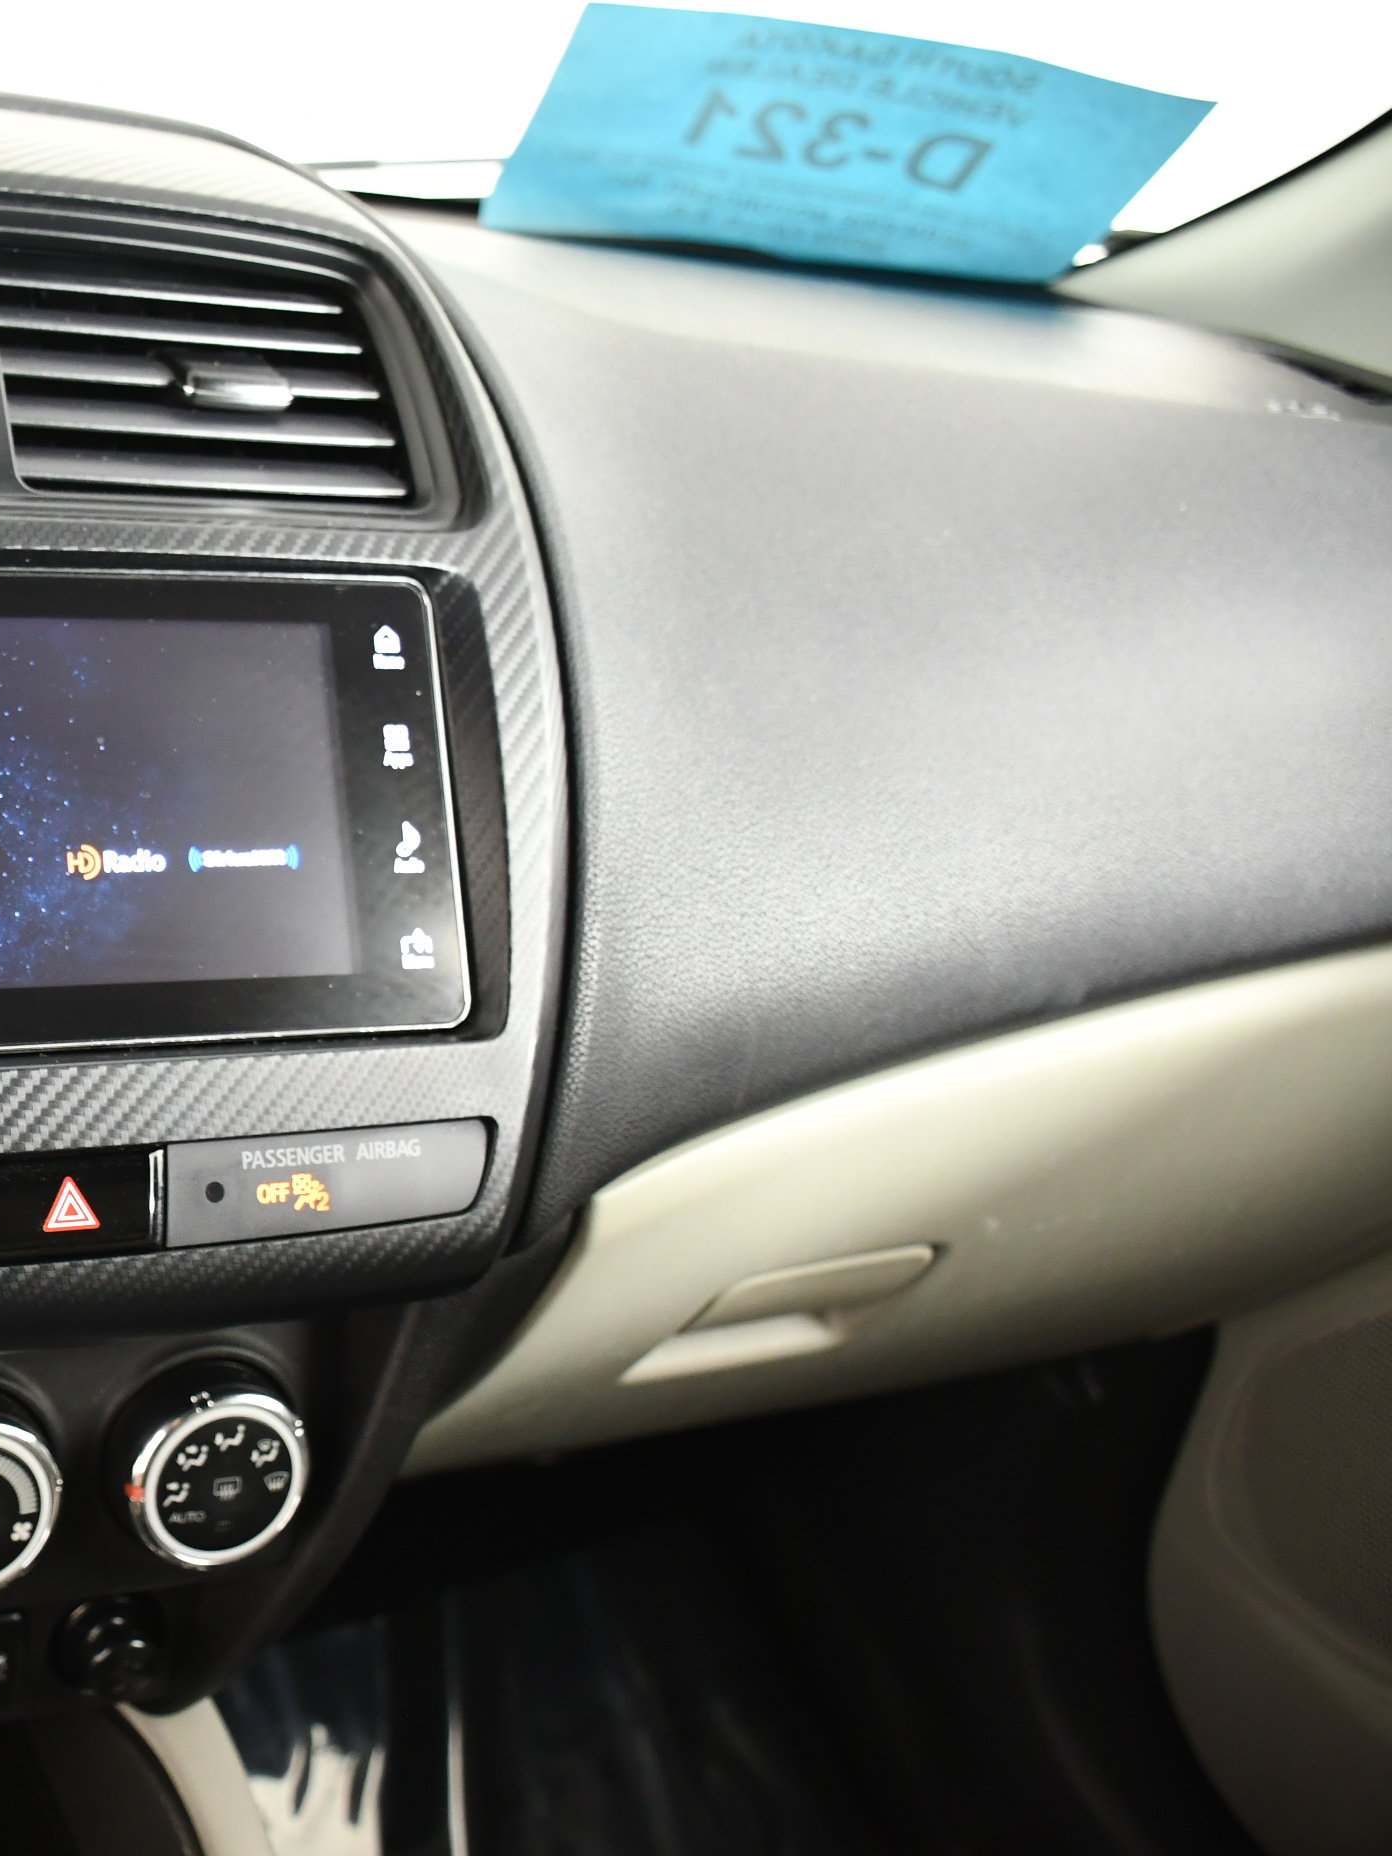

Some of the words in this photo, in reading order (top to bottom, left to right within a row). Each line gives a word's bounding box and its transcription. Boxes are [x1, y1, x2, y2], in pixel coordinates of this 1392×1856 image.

[102, 847, 167, 873] Radio
[241, 1143, 346, 1170] PASSENGER
[356, 1138, 422, 1162] AIRBAG
[256, 1182, 290, 1204] OFF
[168, 1510, 208, 1524] AUTO
